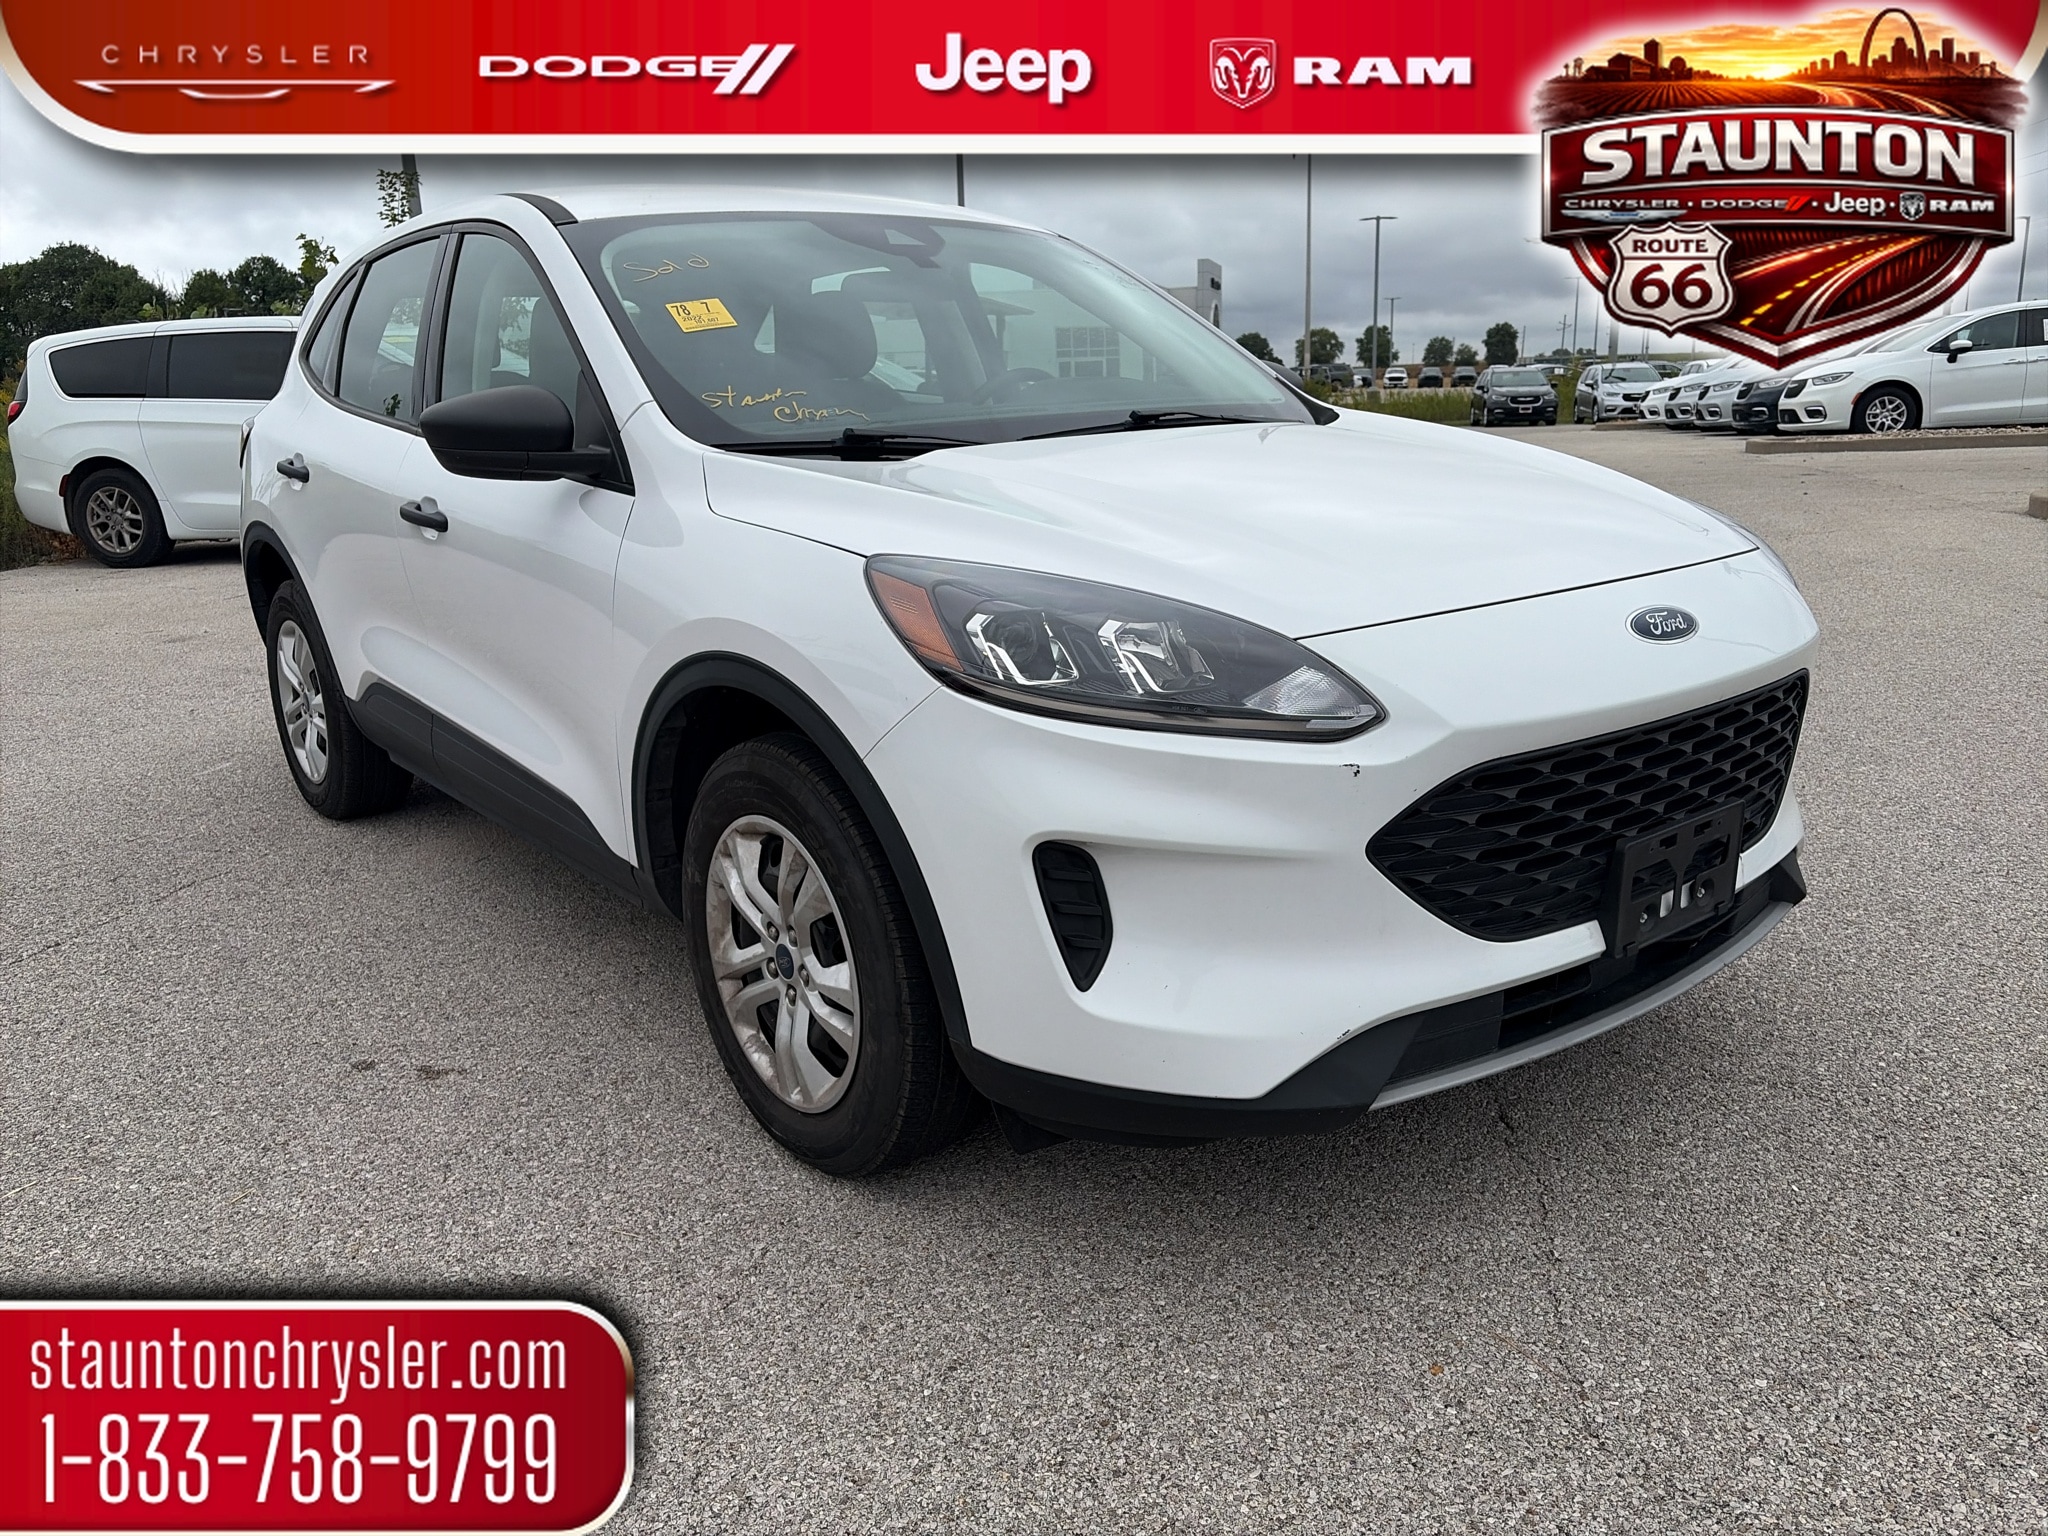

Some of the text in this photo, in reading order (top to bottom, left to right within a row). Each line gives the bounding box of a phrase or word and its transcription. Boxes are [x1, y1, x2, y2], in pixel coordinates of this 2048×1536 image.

[671, 302, 710, 316] 78 7
[1646, 611, 1687, 635] Ford
